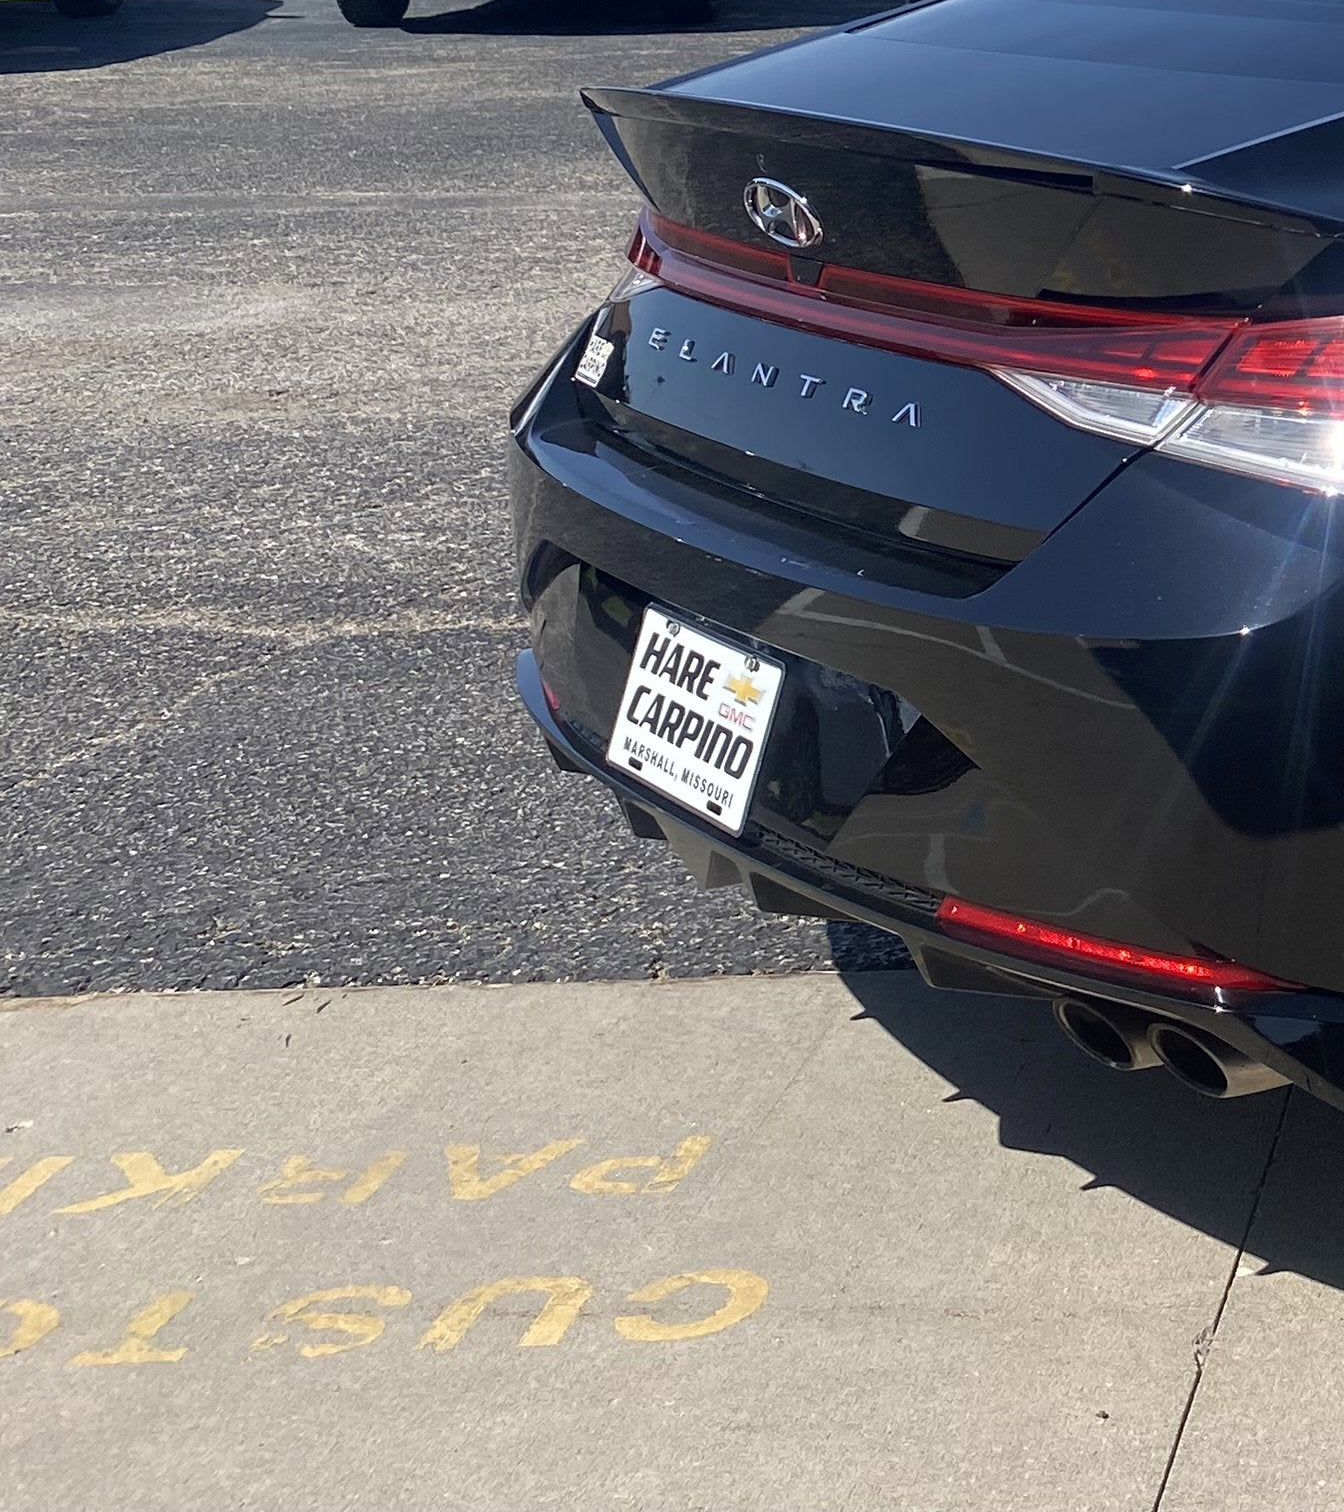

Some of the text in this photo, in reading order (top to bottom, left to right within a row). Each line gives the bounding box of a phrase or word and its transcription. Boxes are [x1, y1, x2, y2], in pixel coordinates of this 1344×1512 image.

[648, 326, 923, 429] ELANTRA
[639, 631, 721, 701] HARE
[626, 684, 754, 780] CARPINO
[717, 701, 757, 731] GMC
[623, 736, 735, 809] MARSHALL, MISSOURI
[0, 1134, 716, 1215] PARKI
